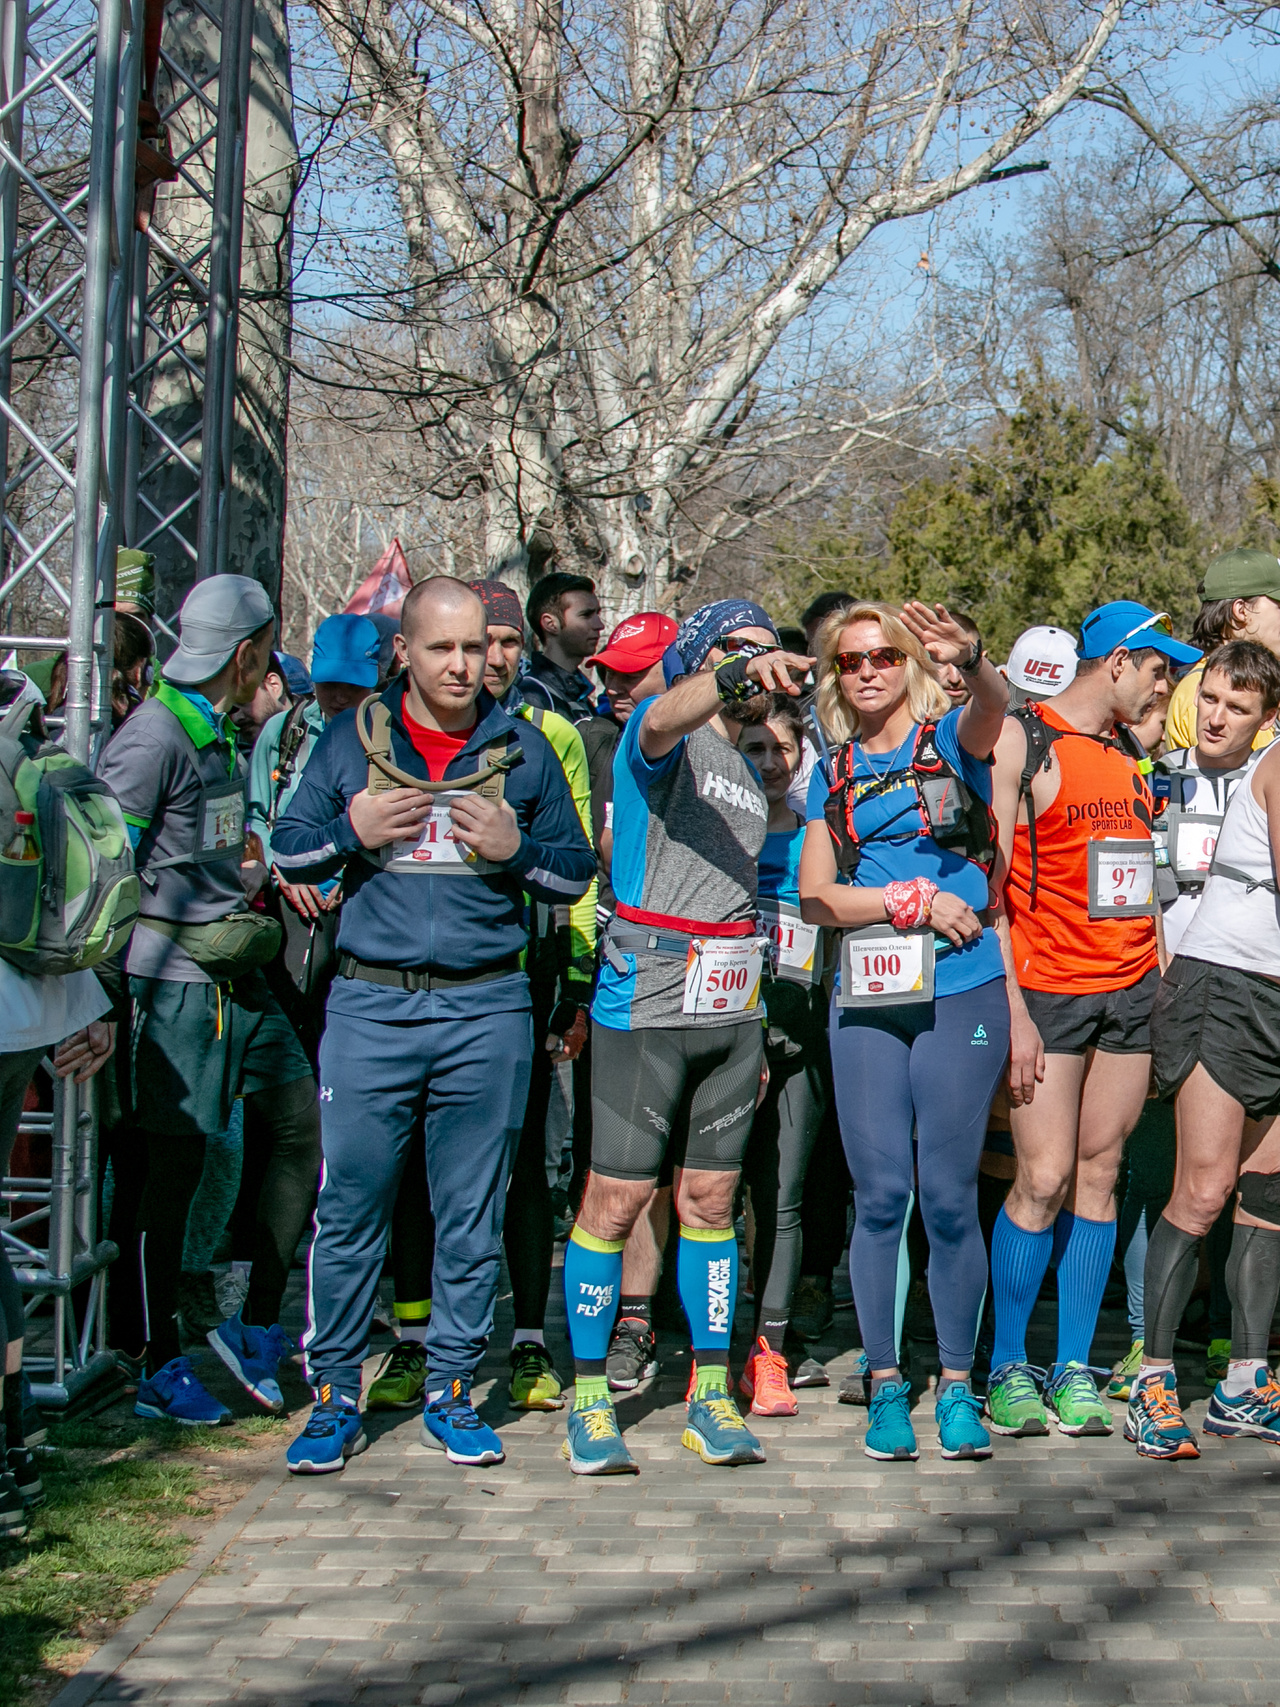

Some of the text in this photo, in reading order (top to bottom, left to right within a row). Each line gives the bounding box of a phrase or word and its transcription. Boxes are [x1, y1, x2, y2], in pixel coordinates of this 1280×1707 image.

[1023, 659, 1064, 679] UFC
[1067, 797, 1132, 827] profeet
[1092, 820, 1132, 831] SPORTS LAB
[1112, 867, 1137, 889] 97
[862, 953, 901, 977] 100
[706, 967, 748, 993] 500
[699, 1105, 742, 1135] MUSCLE
[707, 1260, 720, 1282] ONE
[719, 1256, 731, 1280] ONE
[579, 1282, 615, 1296] TIME
[576, 1303, 604, 1317] FLY
[595, 1295, 613, 1307] TO
[707, 1279, 731, 1334] HOKA
[1233, 1360, 1254, 1369] 2XU
